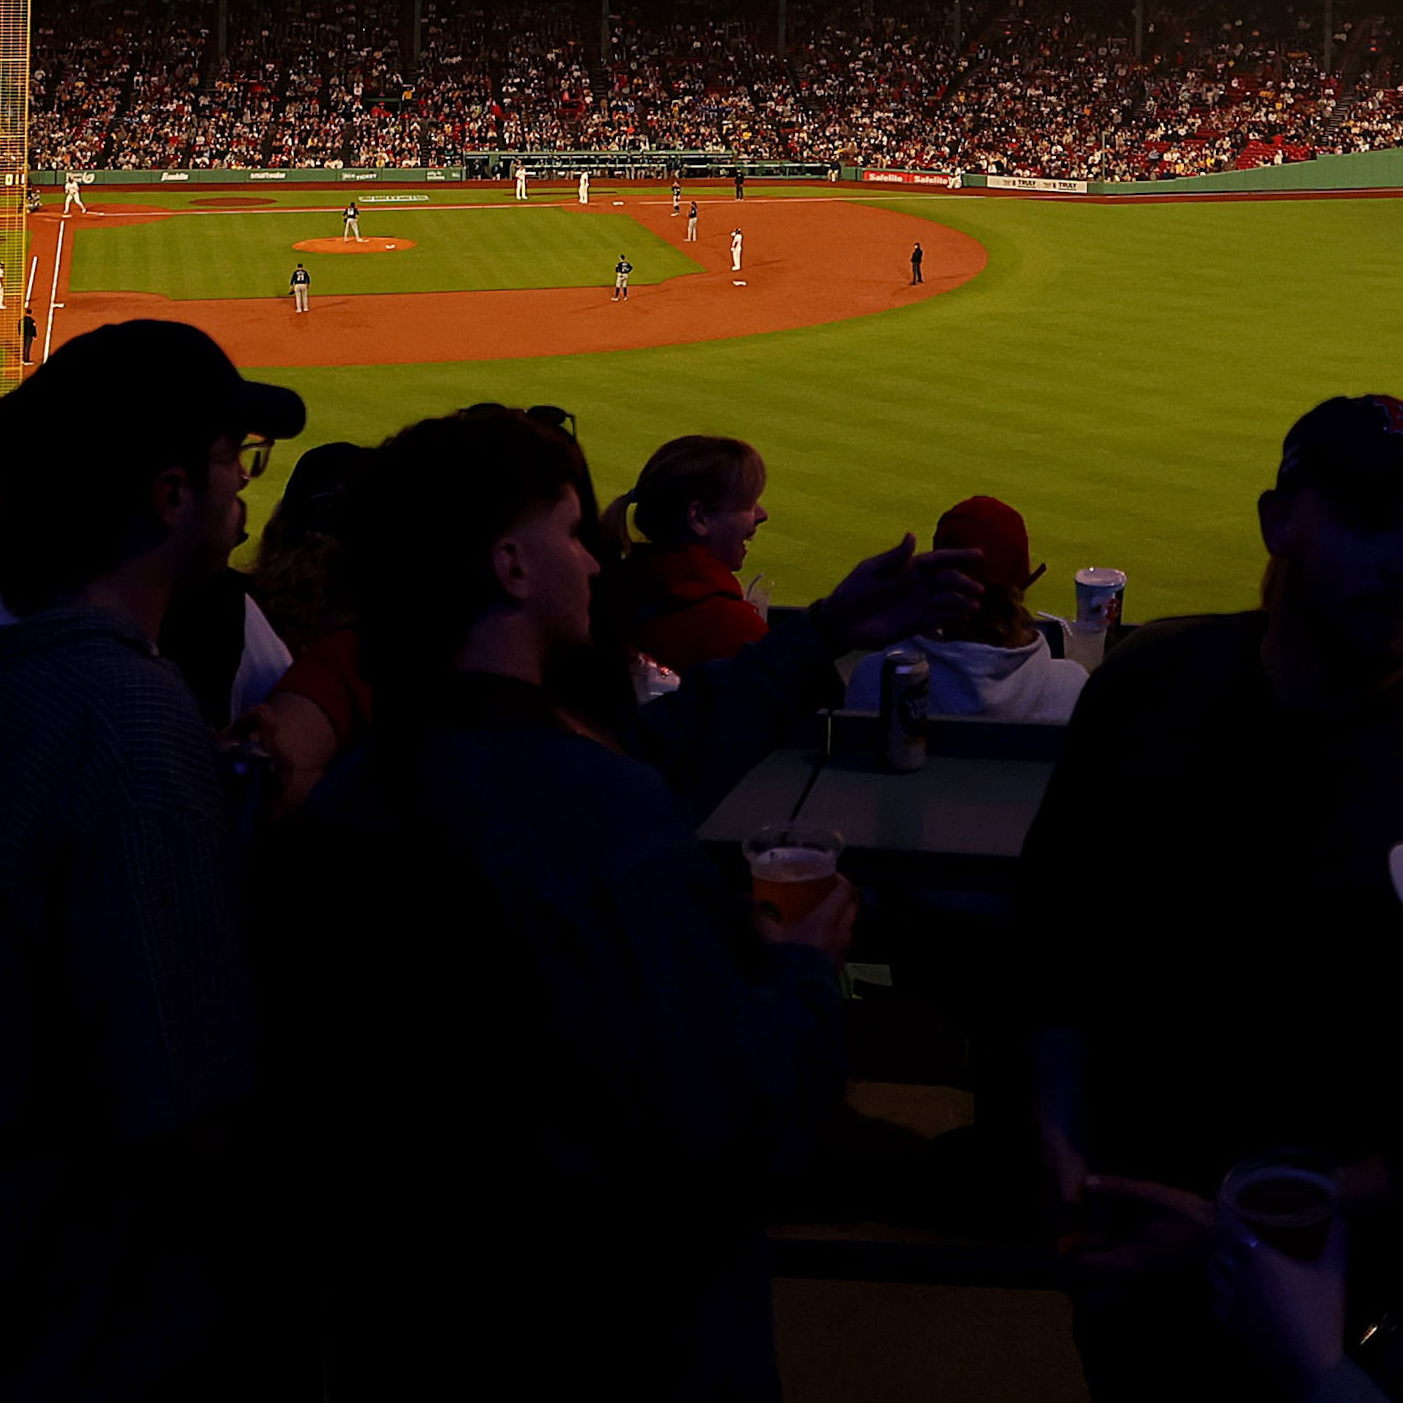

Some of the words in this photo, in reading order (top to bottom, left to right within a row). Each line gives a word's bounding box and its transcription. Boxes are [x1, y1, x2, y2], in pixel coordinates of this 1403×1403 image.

[869, 172, 904, 184] Safelite
[914, 174, 949, 186] Safelite
[1018, 178, 1038, 188] TRULY
[1058, 181, 1078, 191] TRULY
